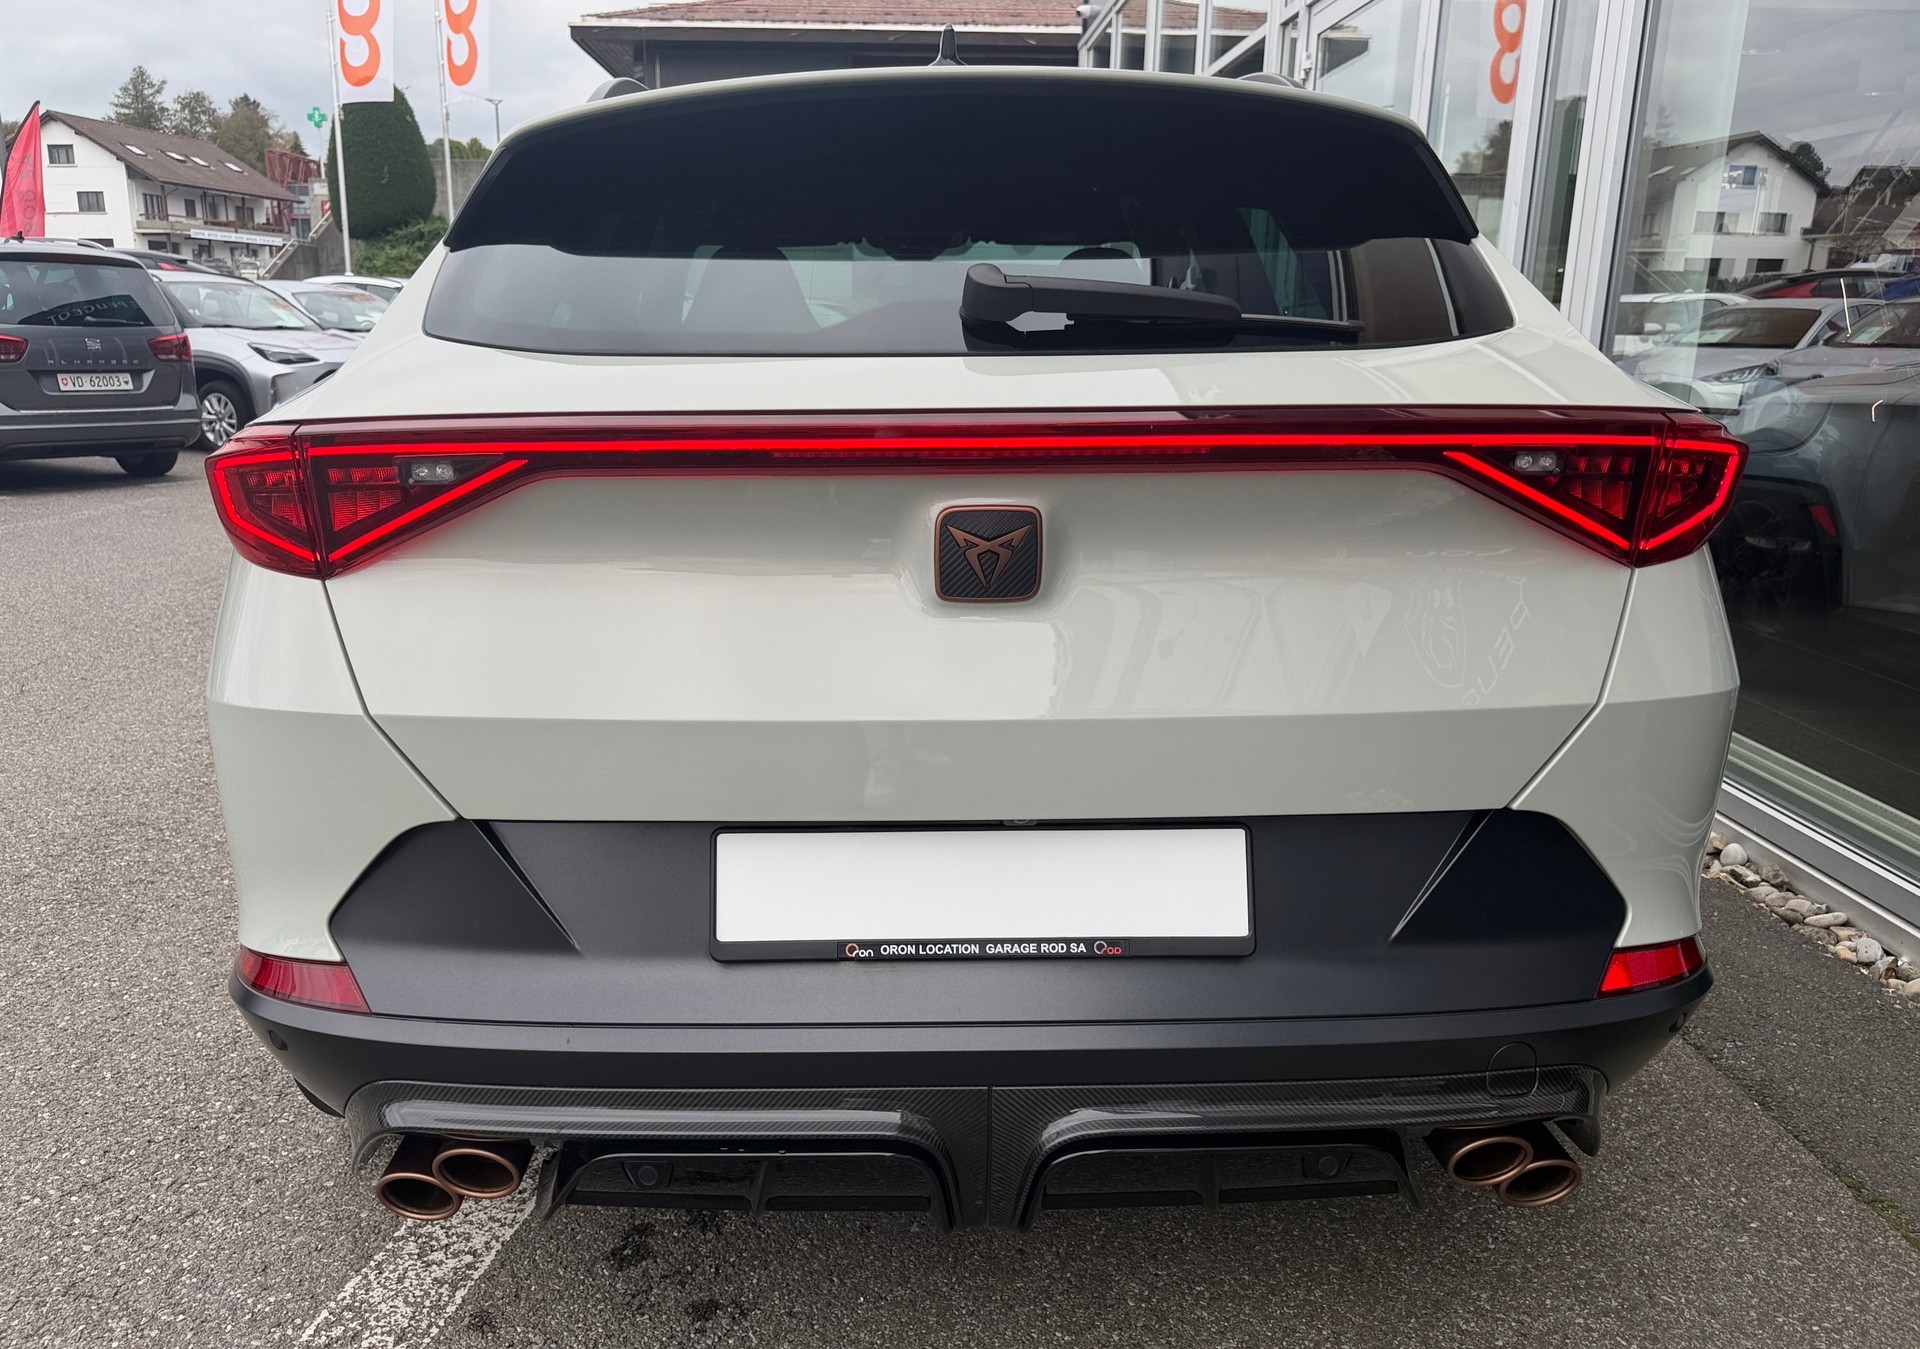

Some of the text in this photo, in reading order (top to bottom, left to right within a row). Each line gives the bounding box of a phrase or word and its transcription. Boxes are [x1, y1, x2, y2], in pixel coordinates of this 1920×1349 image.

[880, 944, 916, 955] ORON
[919, 943, 980, 955] LOCATION
[985, 943, 1038, 954] GARAGE
[1040, 942, 1067, 953] ROD
[1069, 942, 1087, 953] SA
